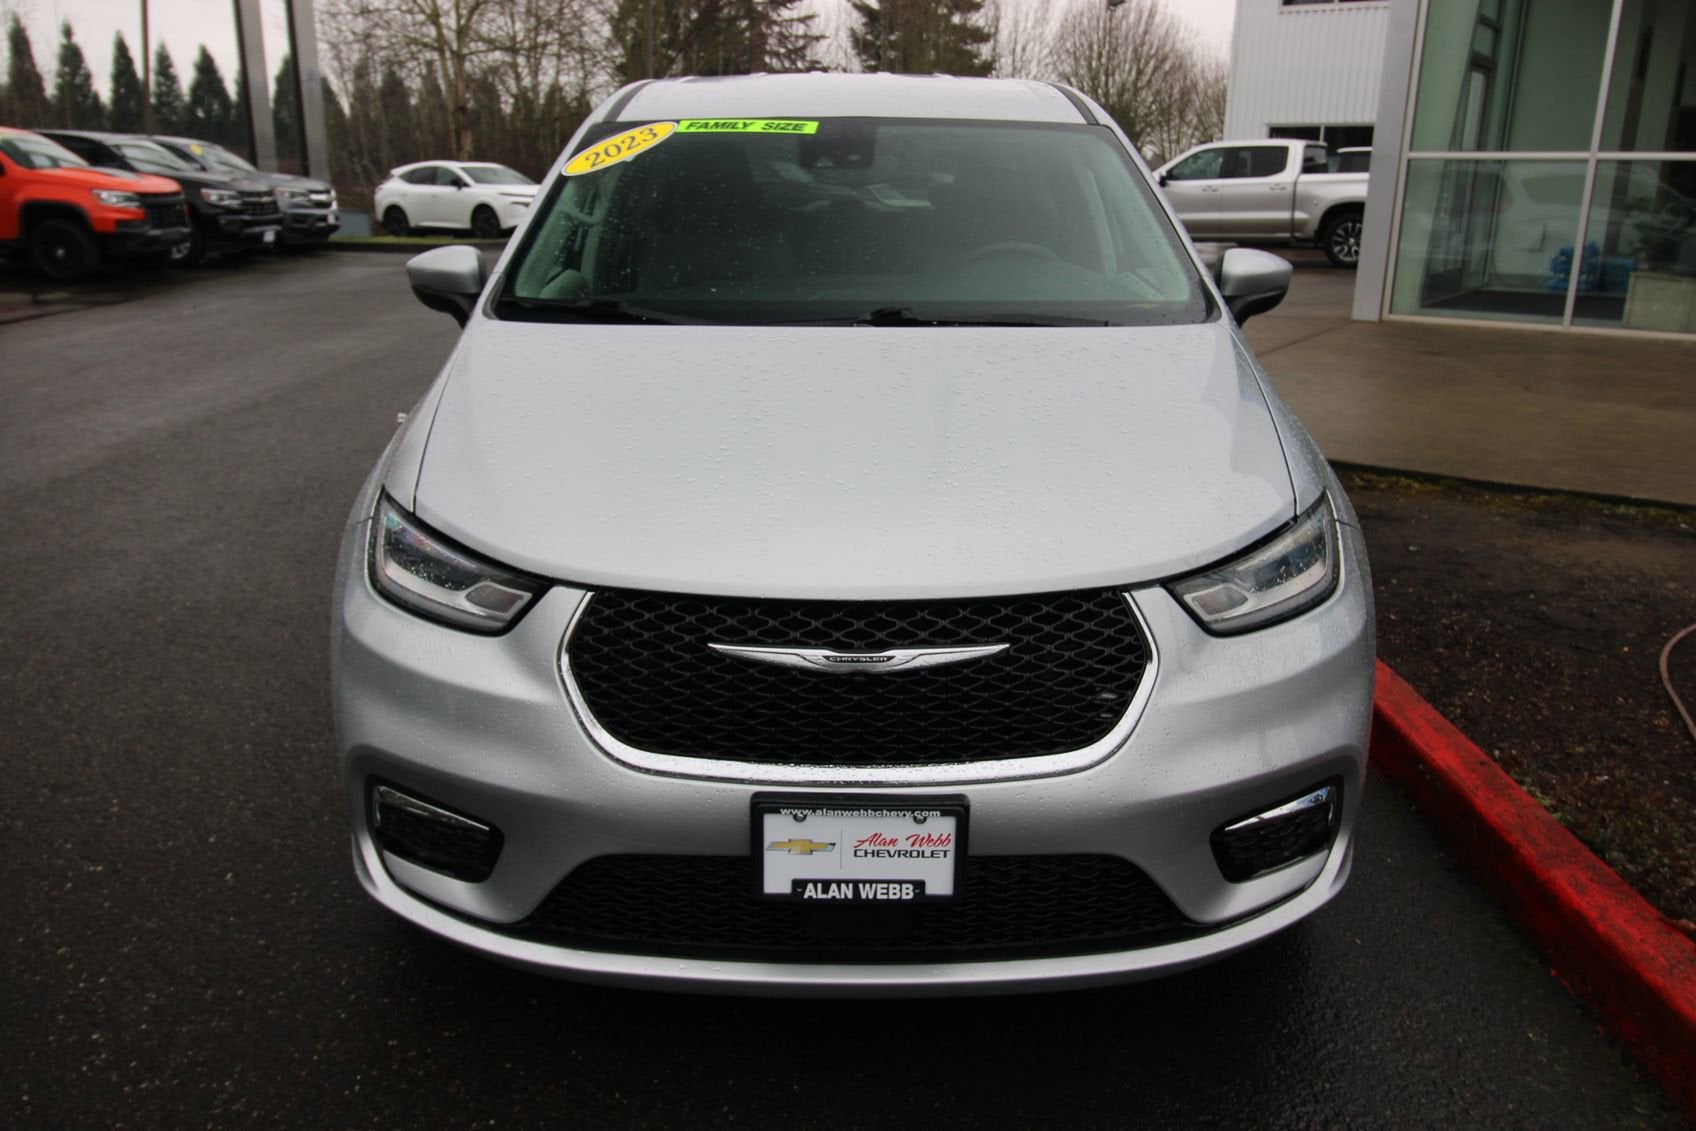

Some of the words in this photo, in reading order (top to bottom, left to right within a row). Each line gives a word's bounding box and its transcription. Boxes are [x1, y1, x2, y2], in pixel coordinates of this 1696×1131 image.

[685, 121, 752, 131] FAMILY
[761, 121, 807, 132] SIZE
[585, 126, 659, 168] 2023
[780, 807, 941, 818] www.alanwebbchevy.com
[853, 832, 898, 849] Alan
[905, 832, 952, 848] Webb
[853, 848, 950, 859] CHEVROLET
[803, 882, 853, 900] ALAN
[859, 883, 914, 900] WEBB
